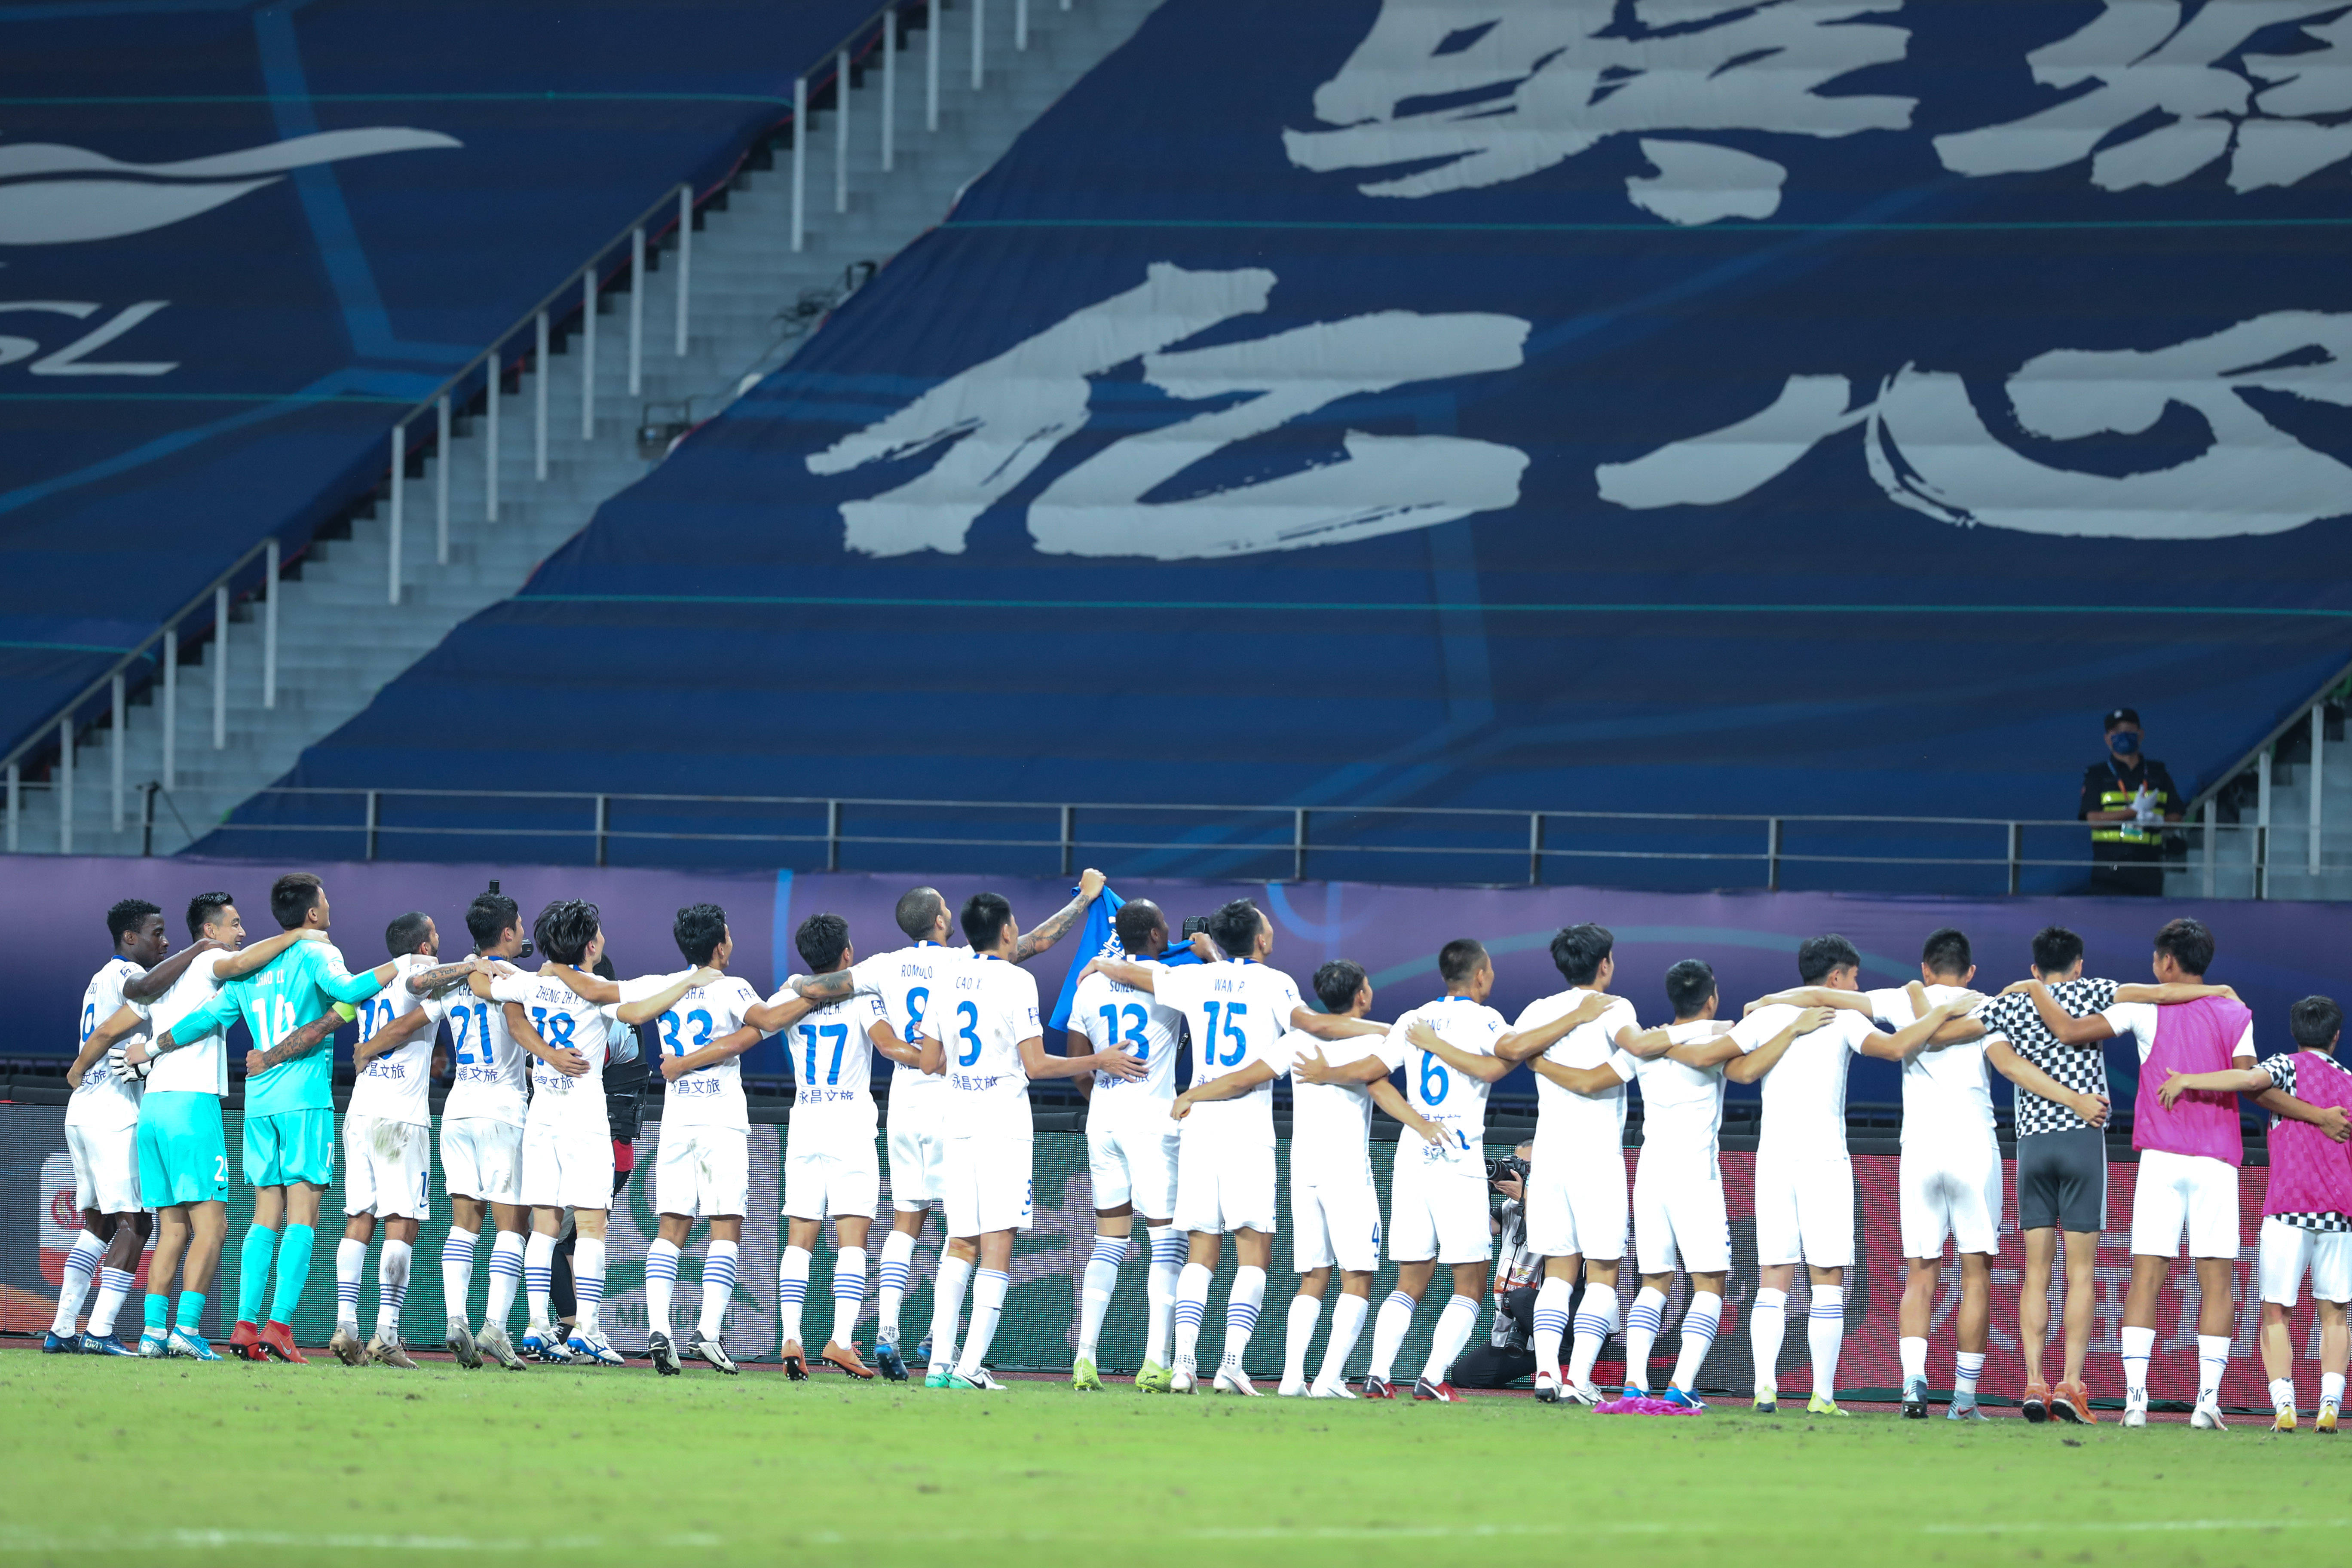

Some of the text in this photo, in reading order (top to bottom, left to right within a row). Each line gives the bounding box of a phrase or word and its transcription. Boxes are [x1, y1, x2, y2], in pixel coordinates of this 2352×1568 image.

[256, 971, 273, 987] SHAO
[536, 985, 560, 1003] ZHENG
[901, 965, 932, 979] ROMULO
[956, 976, 972, 989] CAO
[252, 994, 299, 1066] 14
[360, 999, 395, 1060] 10
[450, 1003, 493, 1065] 21
[532, 1007, 575, 1066] 18
[905, 987, 929, 1044] 8
[957, 1001, 982, 1067] 3
[1099, 1003, 1149, 1060] 13
[1204, 1001, 1247, 1067] 15
[799, 1023, 848, 1085] 17
[1420, 1050, 1449, 1106] 6
[799, 1089, 854, 1105] 永昌文旅
[952, 1075, 998, 1091] 永昌文旅
[421, 1171, 430, 1197] 1
[1025, 1179, 1032, 1205] 3
[1372, 1222, 1379, 1248] 4
